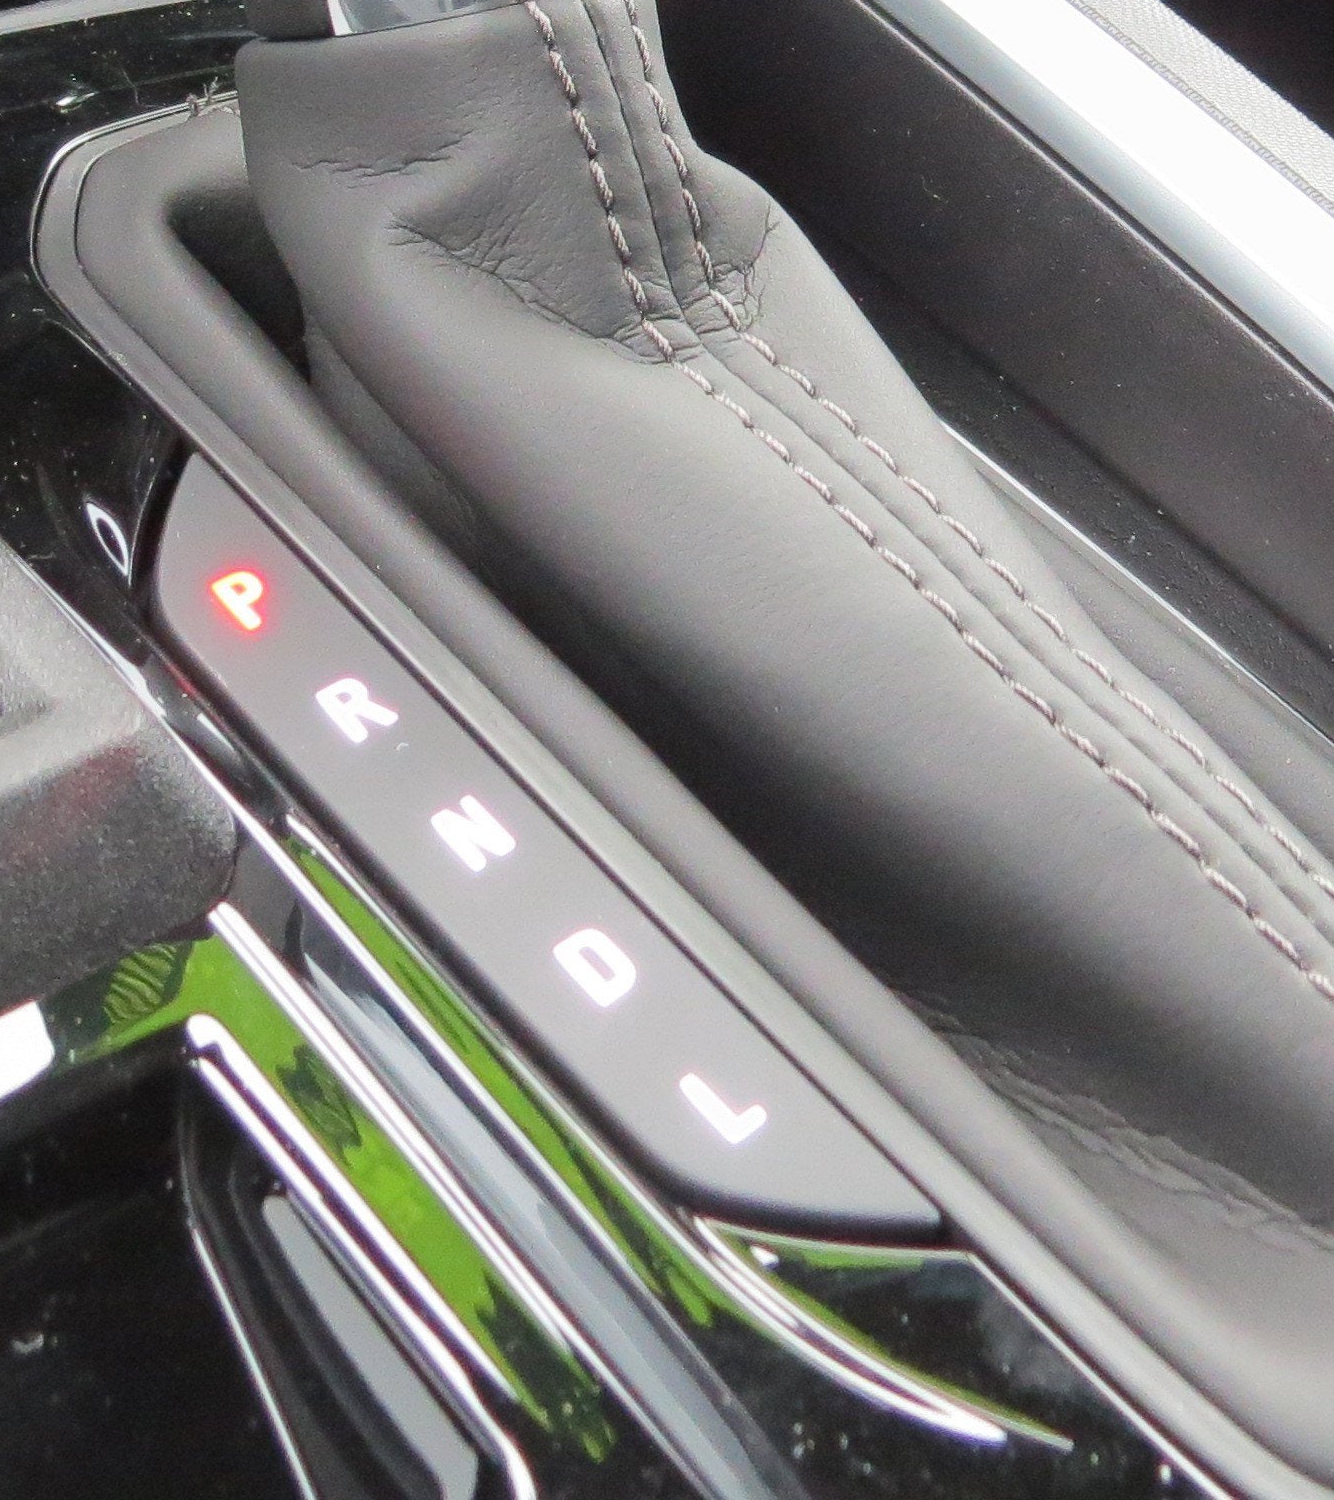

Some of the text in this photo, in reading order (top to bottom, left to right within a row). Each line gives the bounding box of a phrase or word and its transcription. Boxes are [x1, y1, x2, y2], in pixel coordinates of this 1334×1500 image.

[211, 570, 767, 1145] P R N D L
